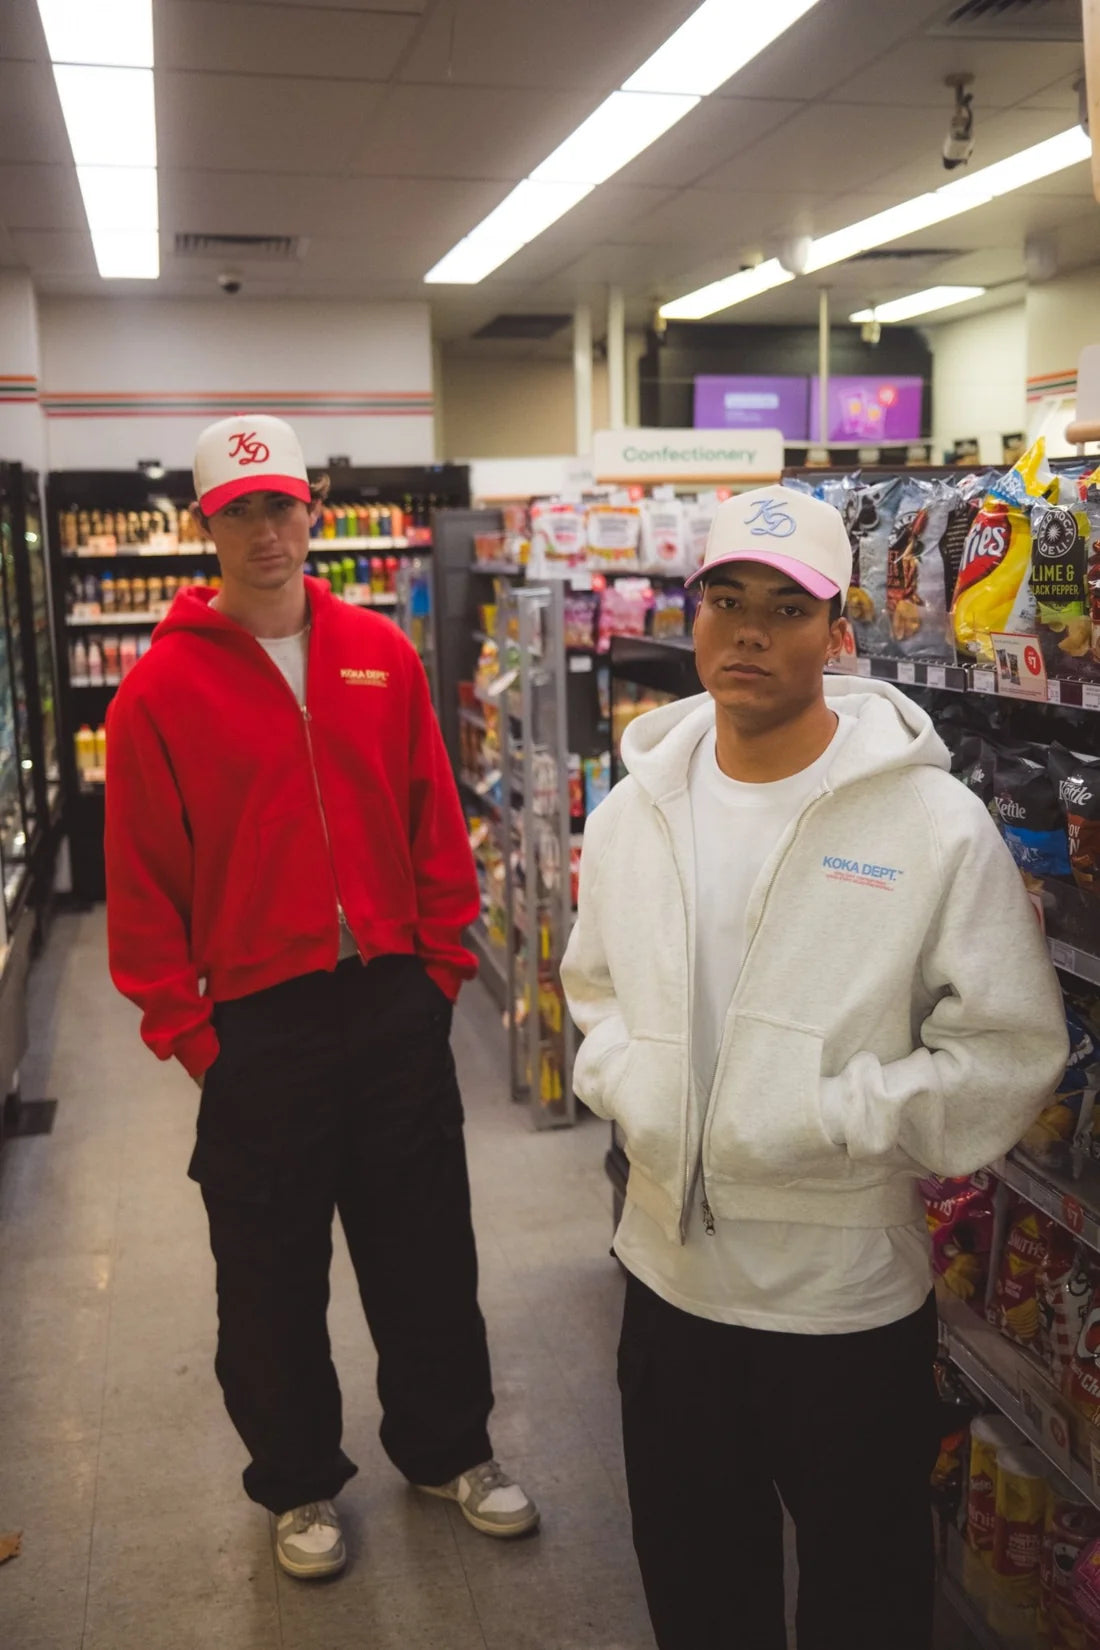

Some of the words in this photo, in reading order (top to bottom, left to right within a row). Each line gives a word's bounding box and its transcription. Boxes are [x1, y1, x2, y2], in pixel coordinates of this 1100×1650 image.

[623, 446, 757, 464] Confectionery
[1054, 509, 1075, 537] ROCK
[1040, 542, 1068, 556] DELI
[1032, 564, 1064, 582] LIME
[1066, 564, 1076, 581] &
[1052, 584, 1080, 597] PEPPER
[823, 856, 860, 874] KOKA
